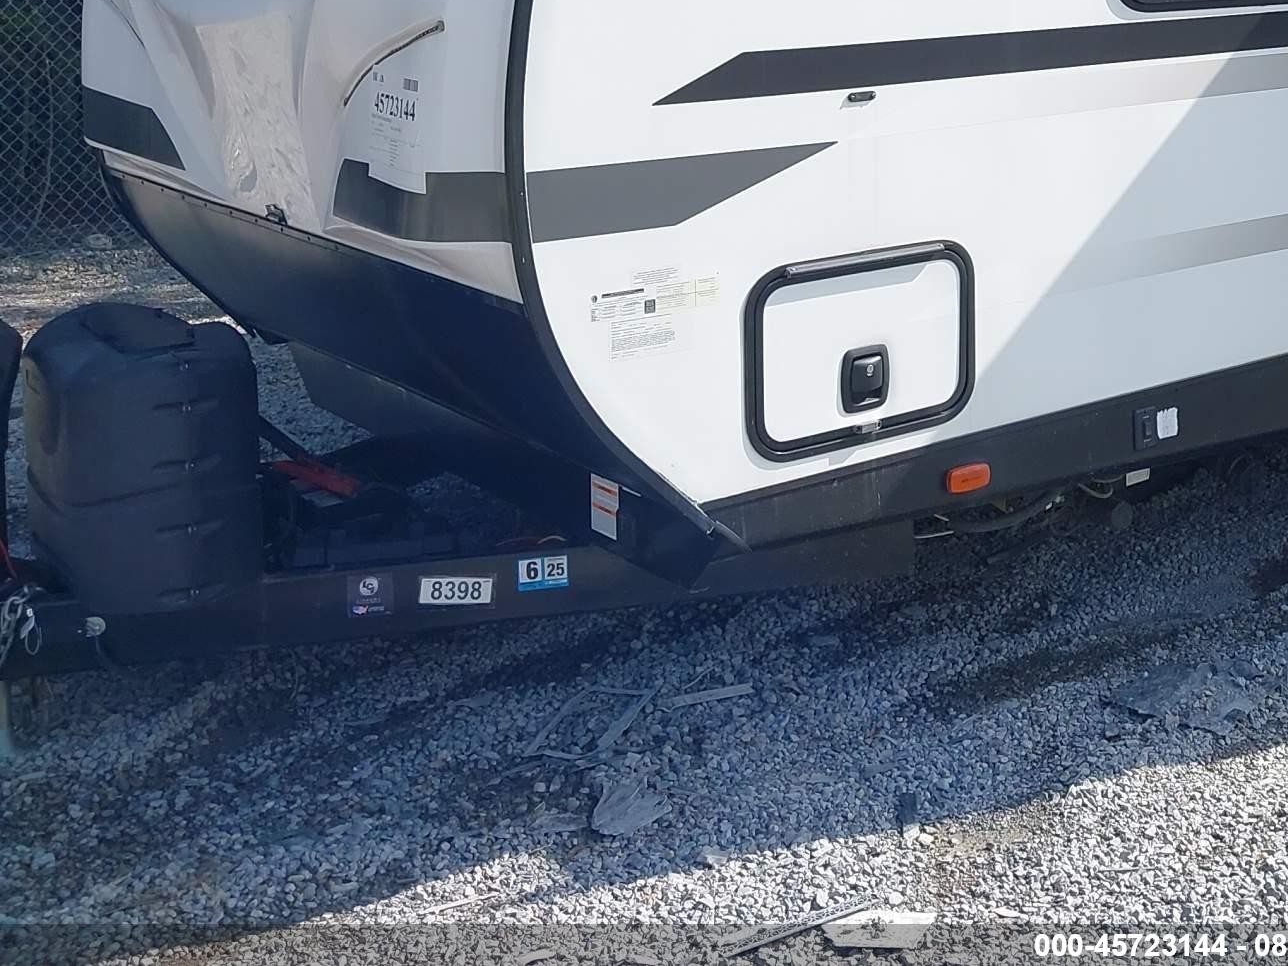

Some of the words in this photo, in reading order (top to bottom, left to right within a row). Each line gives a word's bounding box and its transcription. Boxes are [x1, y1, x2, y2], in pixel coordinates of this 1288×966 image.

[374, 91, 416, 122] 45723144
[526, 561, 539, 580] 6
[546, 562, 565, 577] 25
[430, 581, 482, 601] 8398
